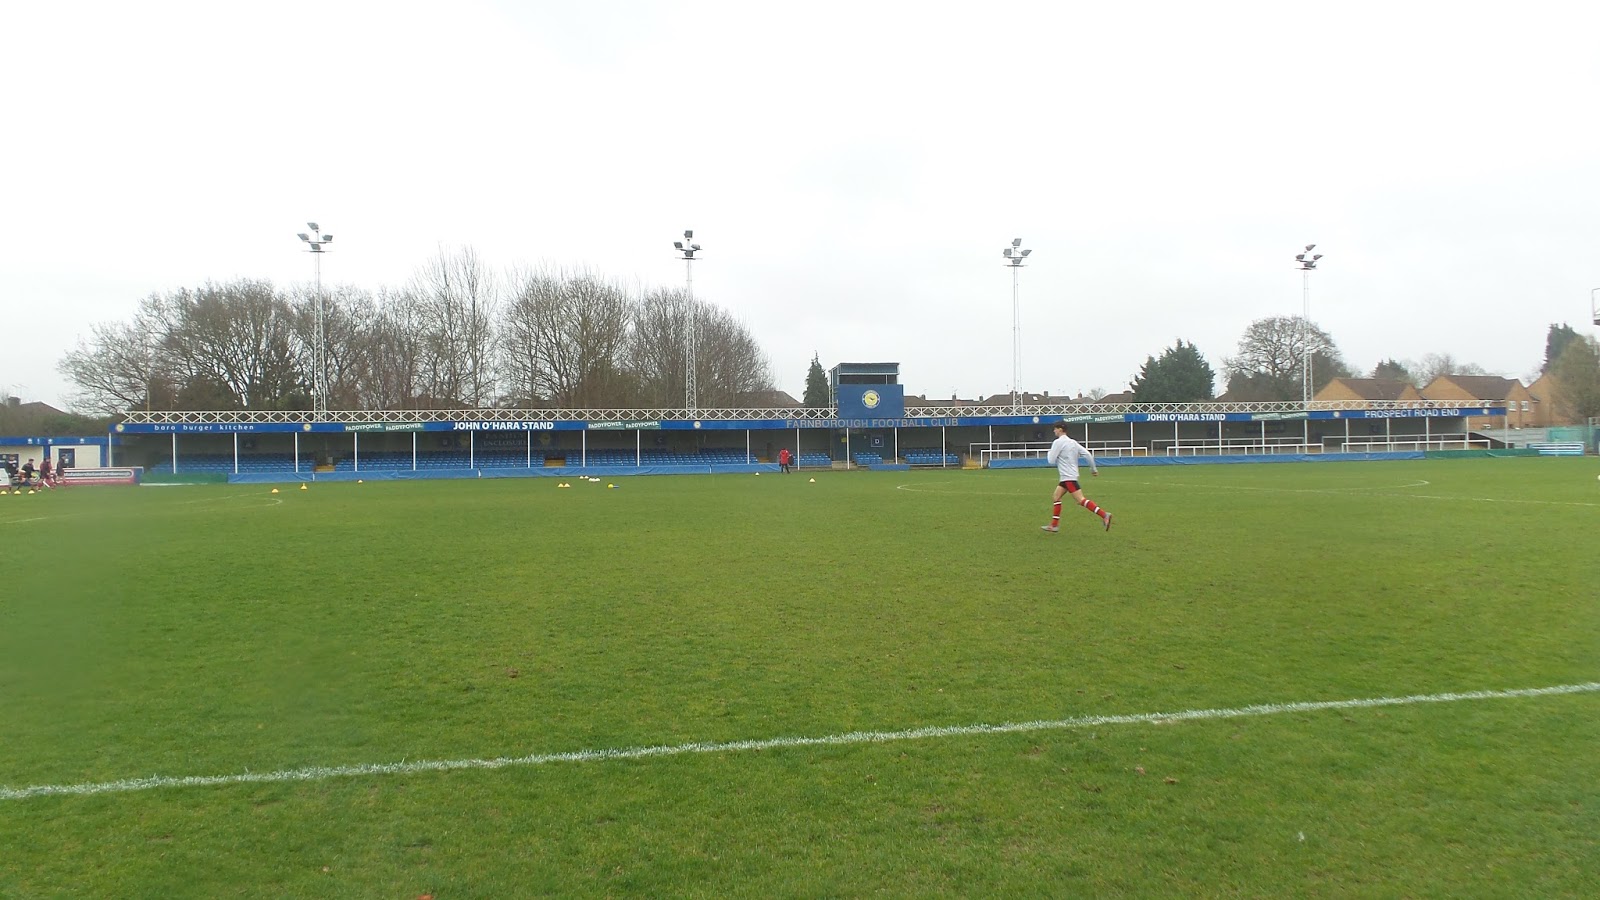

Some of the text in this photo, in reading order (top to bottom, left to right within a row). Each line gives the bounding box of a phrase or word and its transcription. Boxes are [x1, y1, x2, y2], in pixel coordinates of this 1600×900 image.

[1364, 408, 1460, 418] PROSPECT ROAD END
[453, 422, 554, 430] JOHN O'HARA STAND
[786, 418, 958, 428] FARNBOROUGH FOOTBALL CLUB
